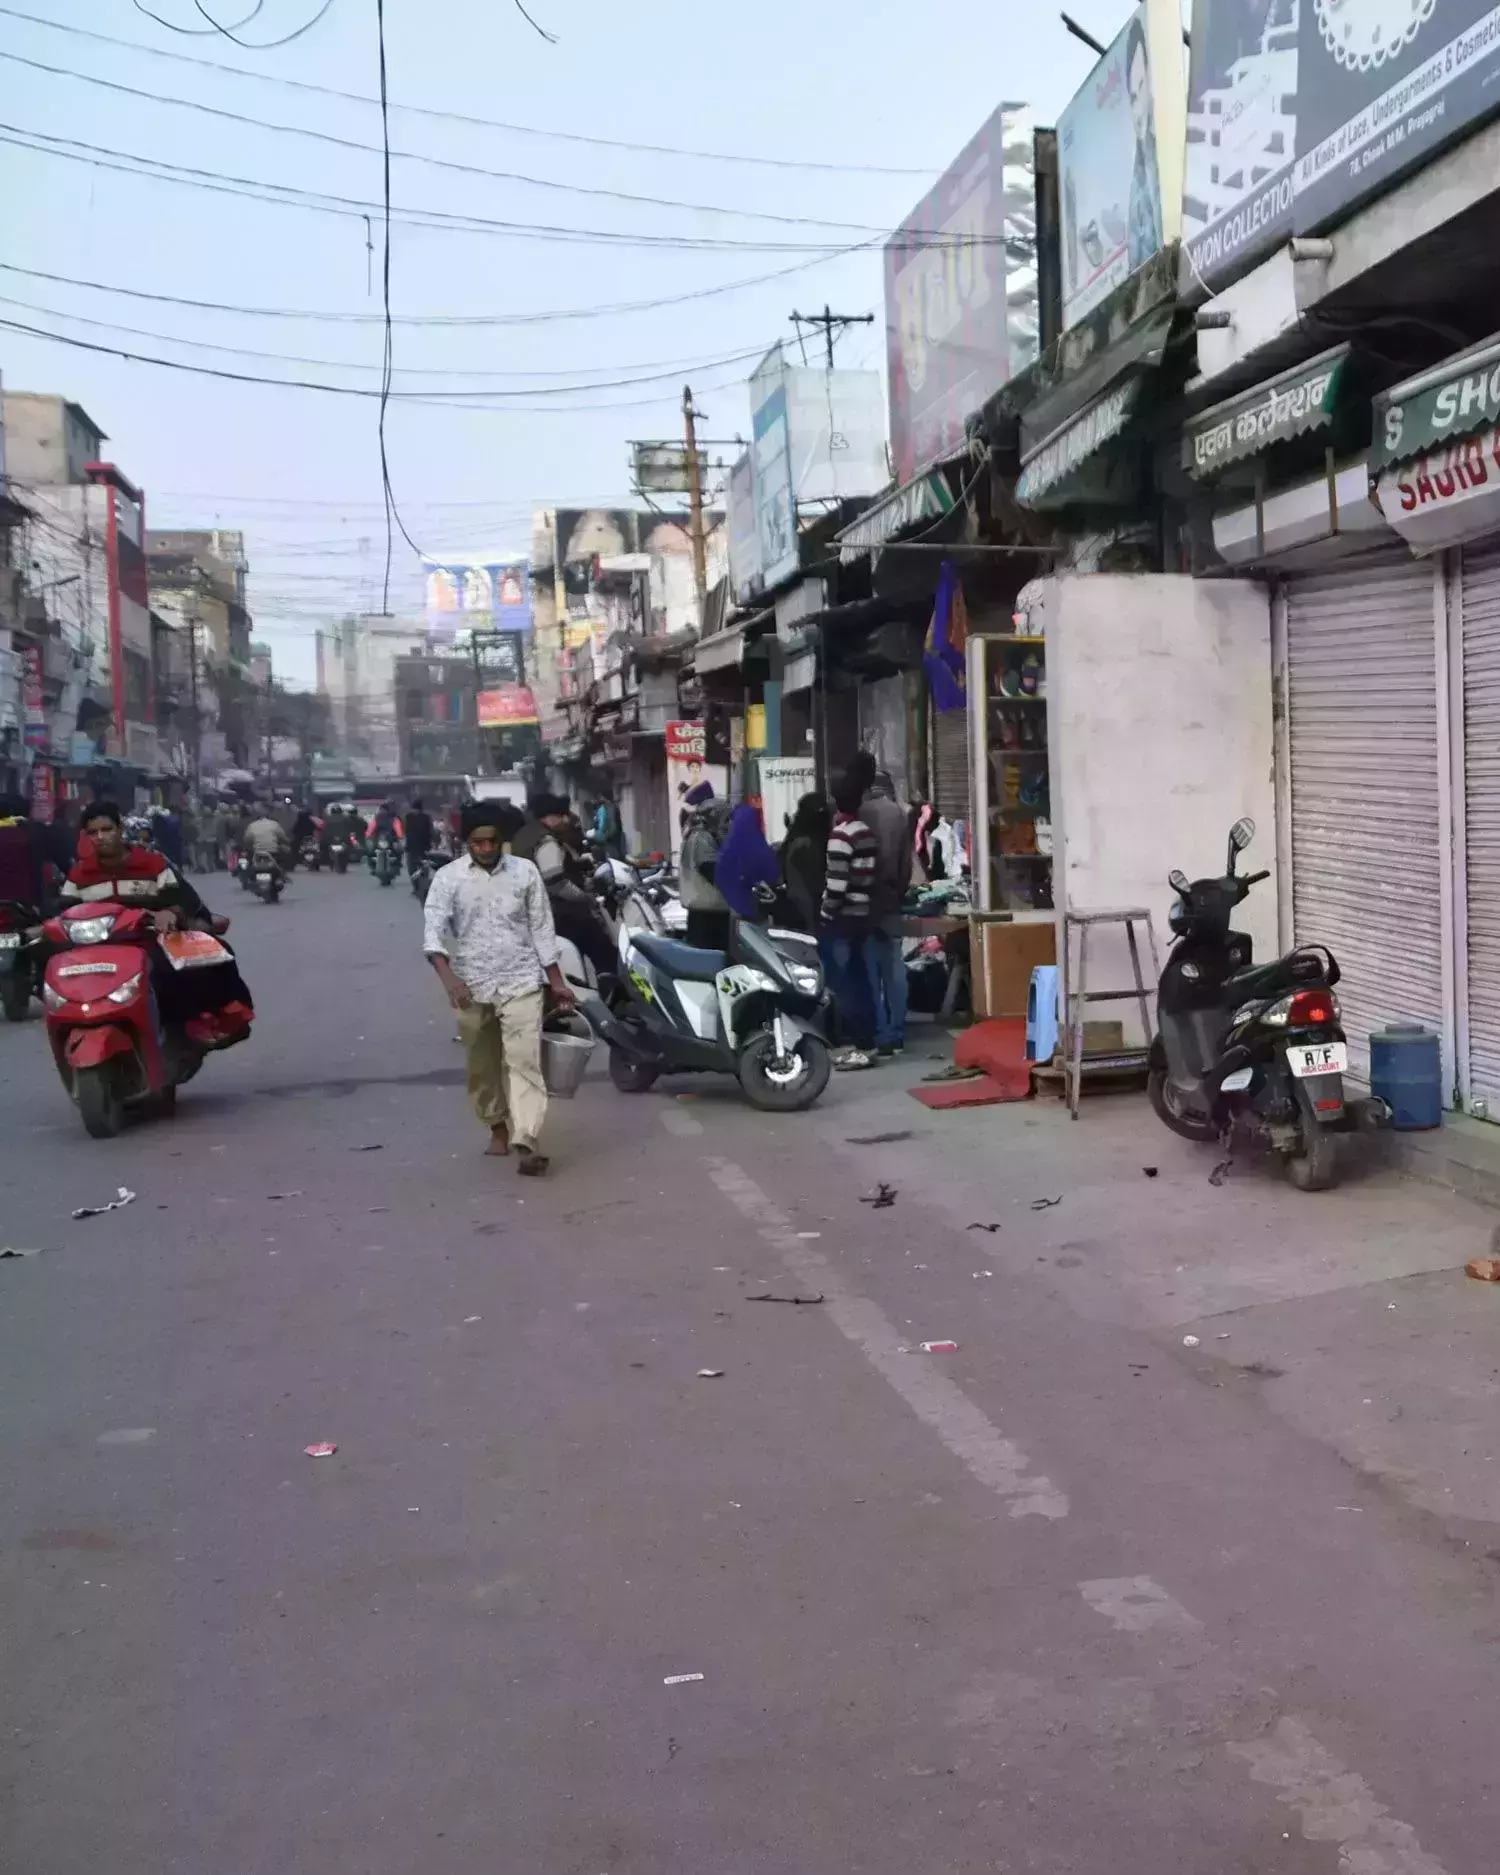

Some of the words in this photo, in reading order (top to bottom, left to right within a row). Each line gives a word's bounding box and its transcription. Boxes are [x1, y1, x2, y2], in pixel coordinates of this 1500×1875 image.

[1373, 60, 1442, 127] Undergarments
[1445, 47, 1453, 73] &
[1304, 1049, 1332, 1066] A/F
